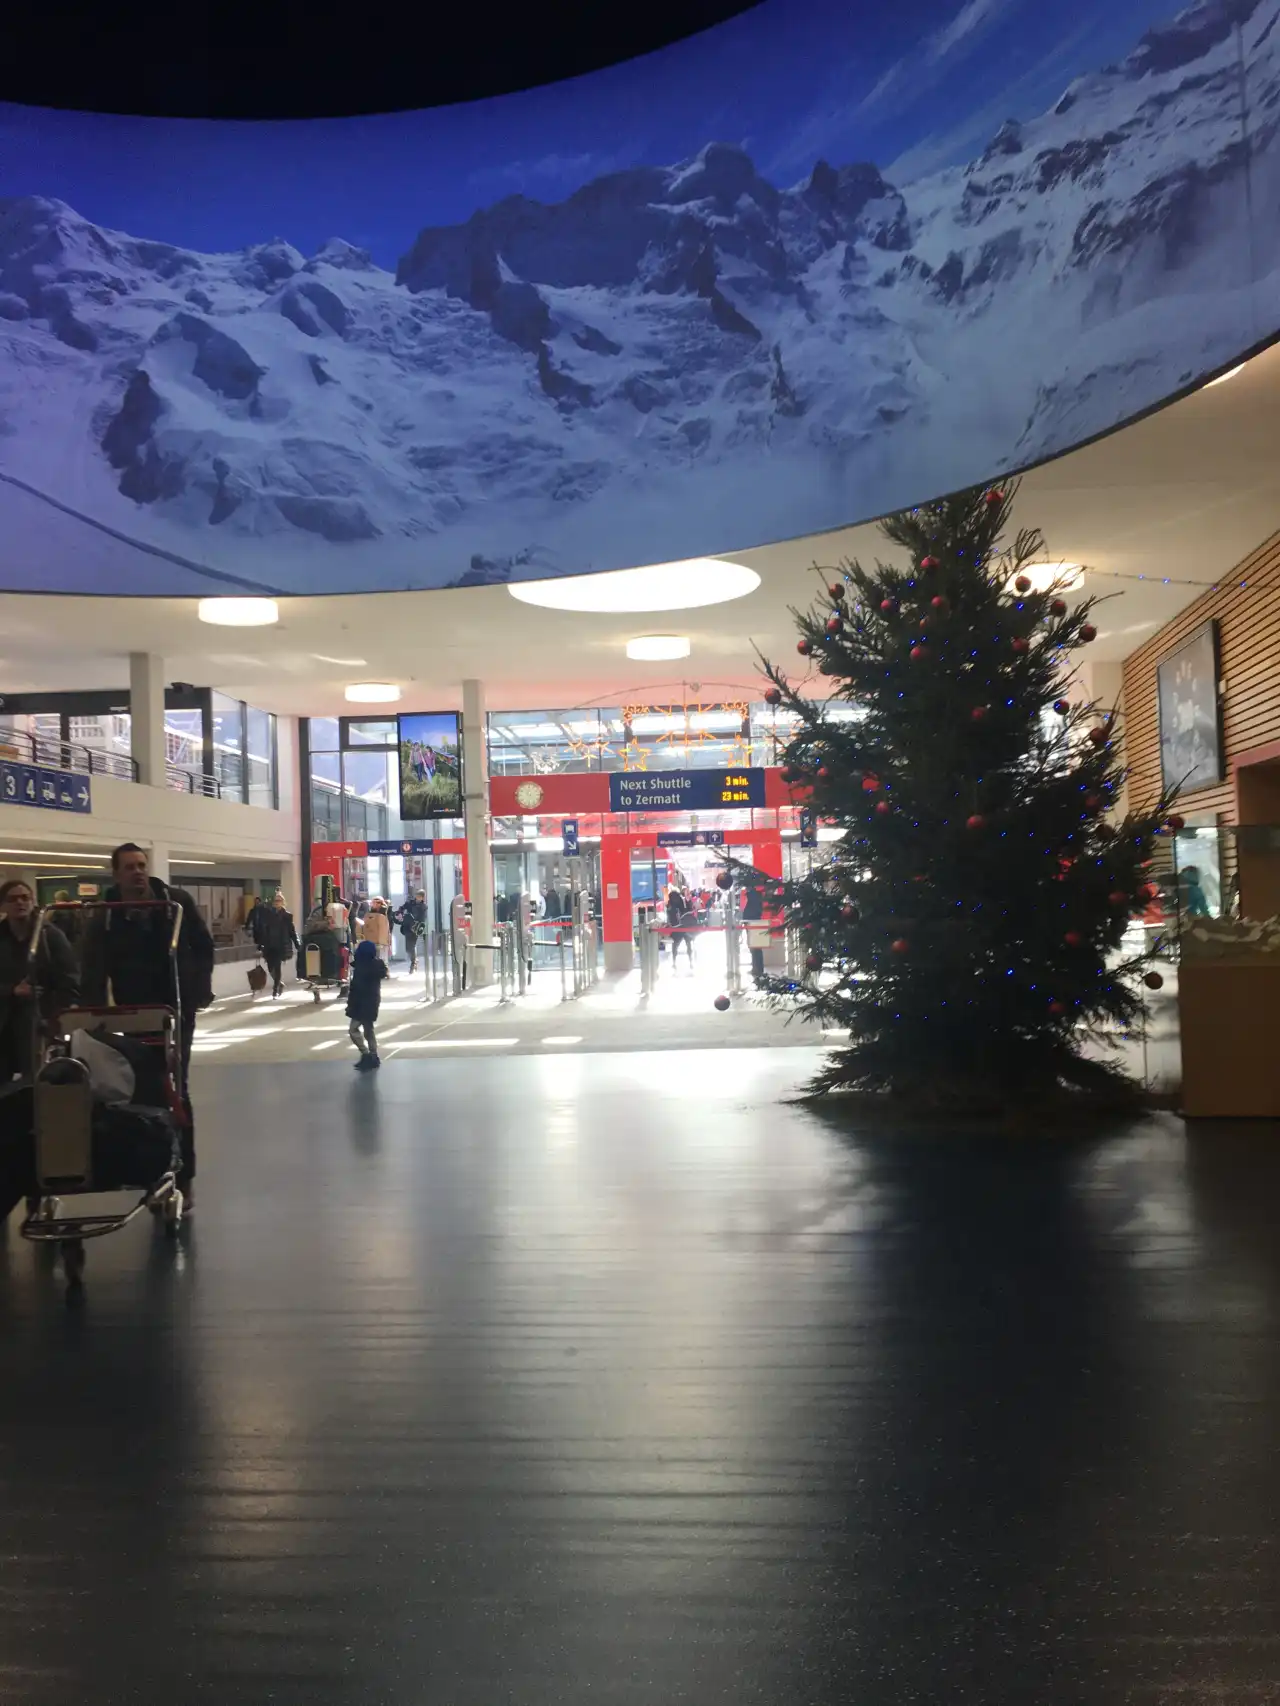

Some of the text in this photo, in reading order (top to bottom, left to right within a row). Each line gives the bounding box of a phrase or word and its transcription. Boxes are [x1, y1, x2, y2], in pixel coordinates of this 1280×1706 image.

[620, 777, 692, 790] Next Shuttle
[725, 775, 731, 786] 3
[6, 775, 35, 799] 3 4
[620, 793, 681, 805] to Zermatt
[722, 791, 732, 801] 23
